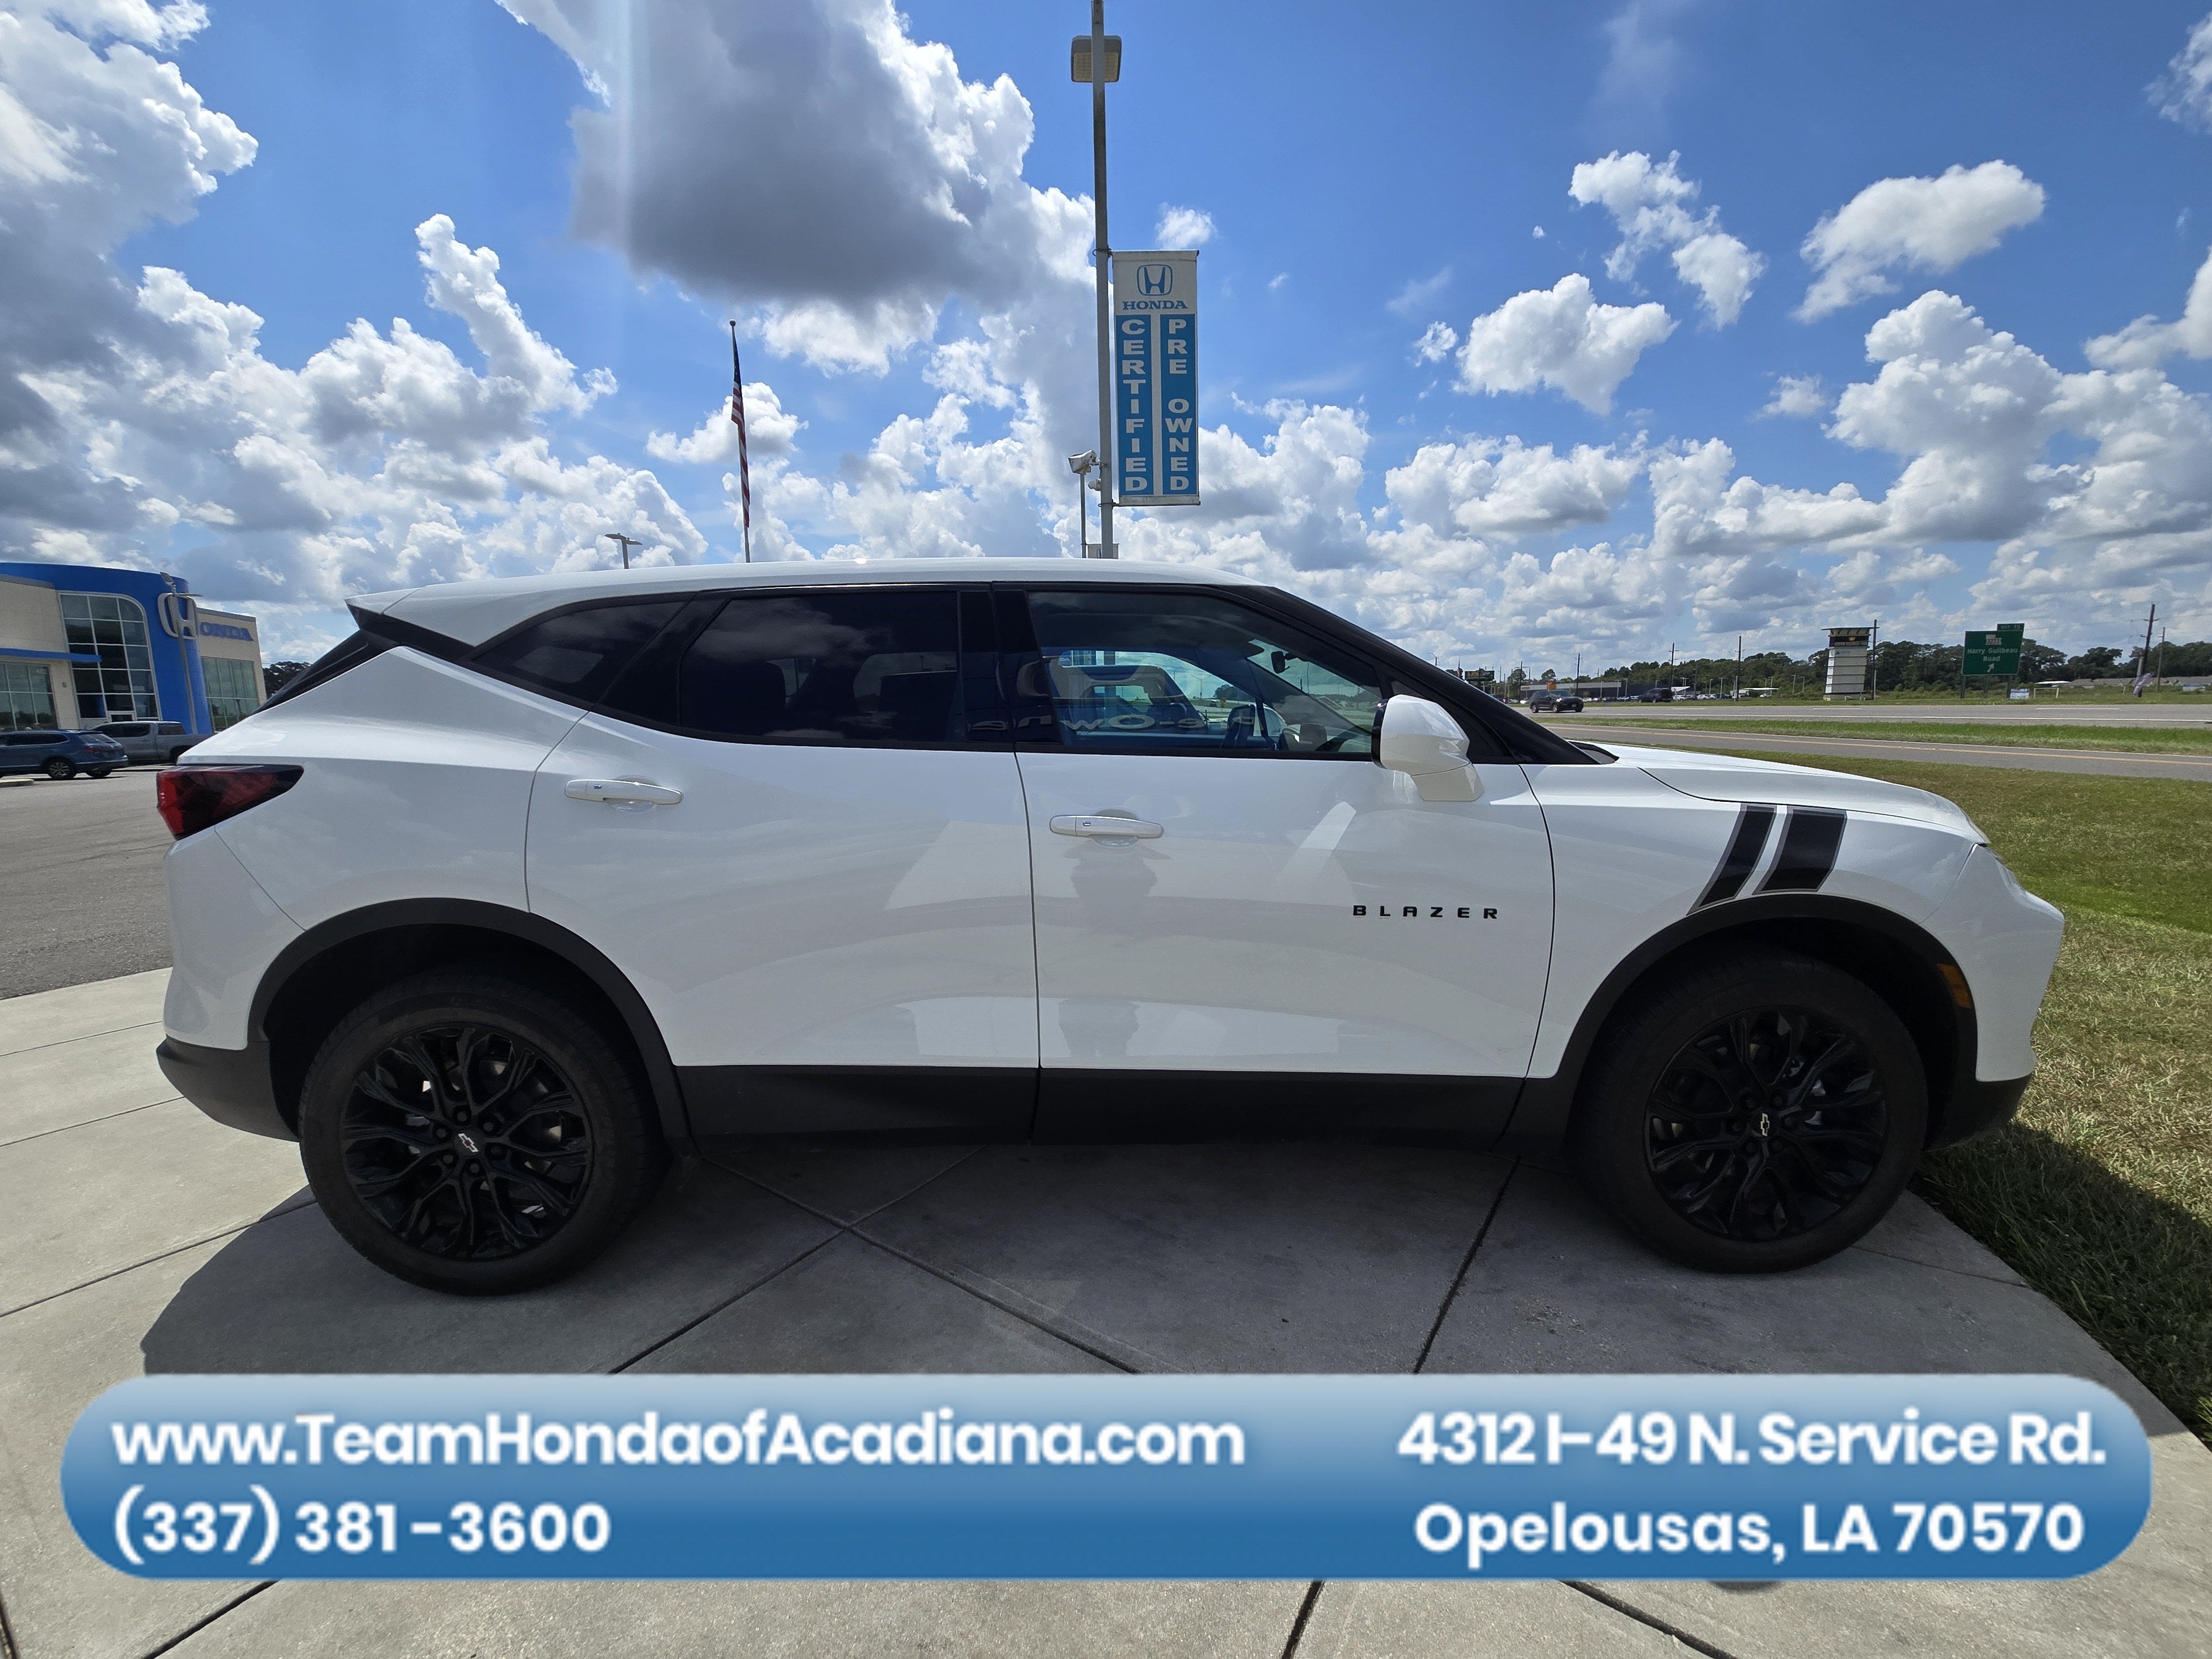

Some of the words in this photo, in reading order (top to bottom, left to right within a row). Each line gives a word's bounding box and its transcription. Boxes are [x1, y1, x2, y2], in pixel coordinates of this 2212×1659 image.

[1122, 300, 1188, 310] HONDA
[1167, 319, 1187, 374] PRE
[1121, 319, 1147, 492] CERTIFIED
[1165, 398, 1193, 491] OWNED
[200, 622, 254, 641] ONDA
[1353, 905, 1498, 919] BLAZER
